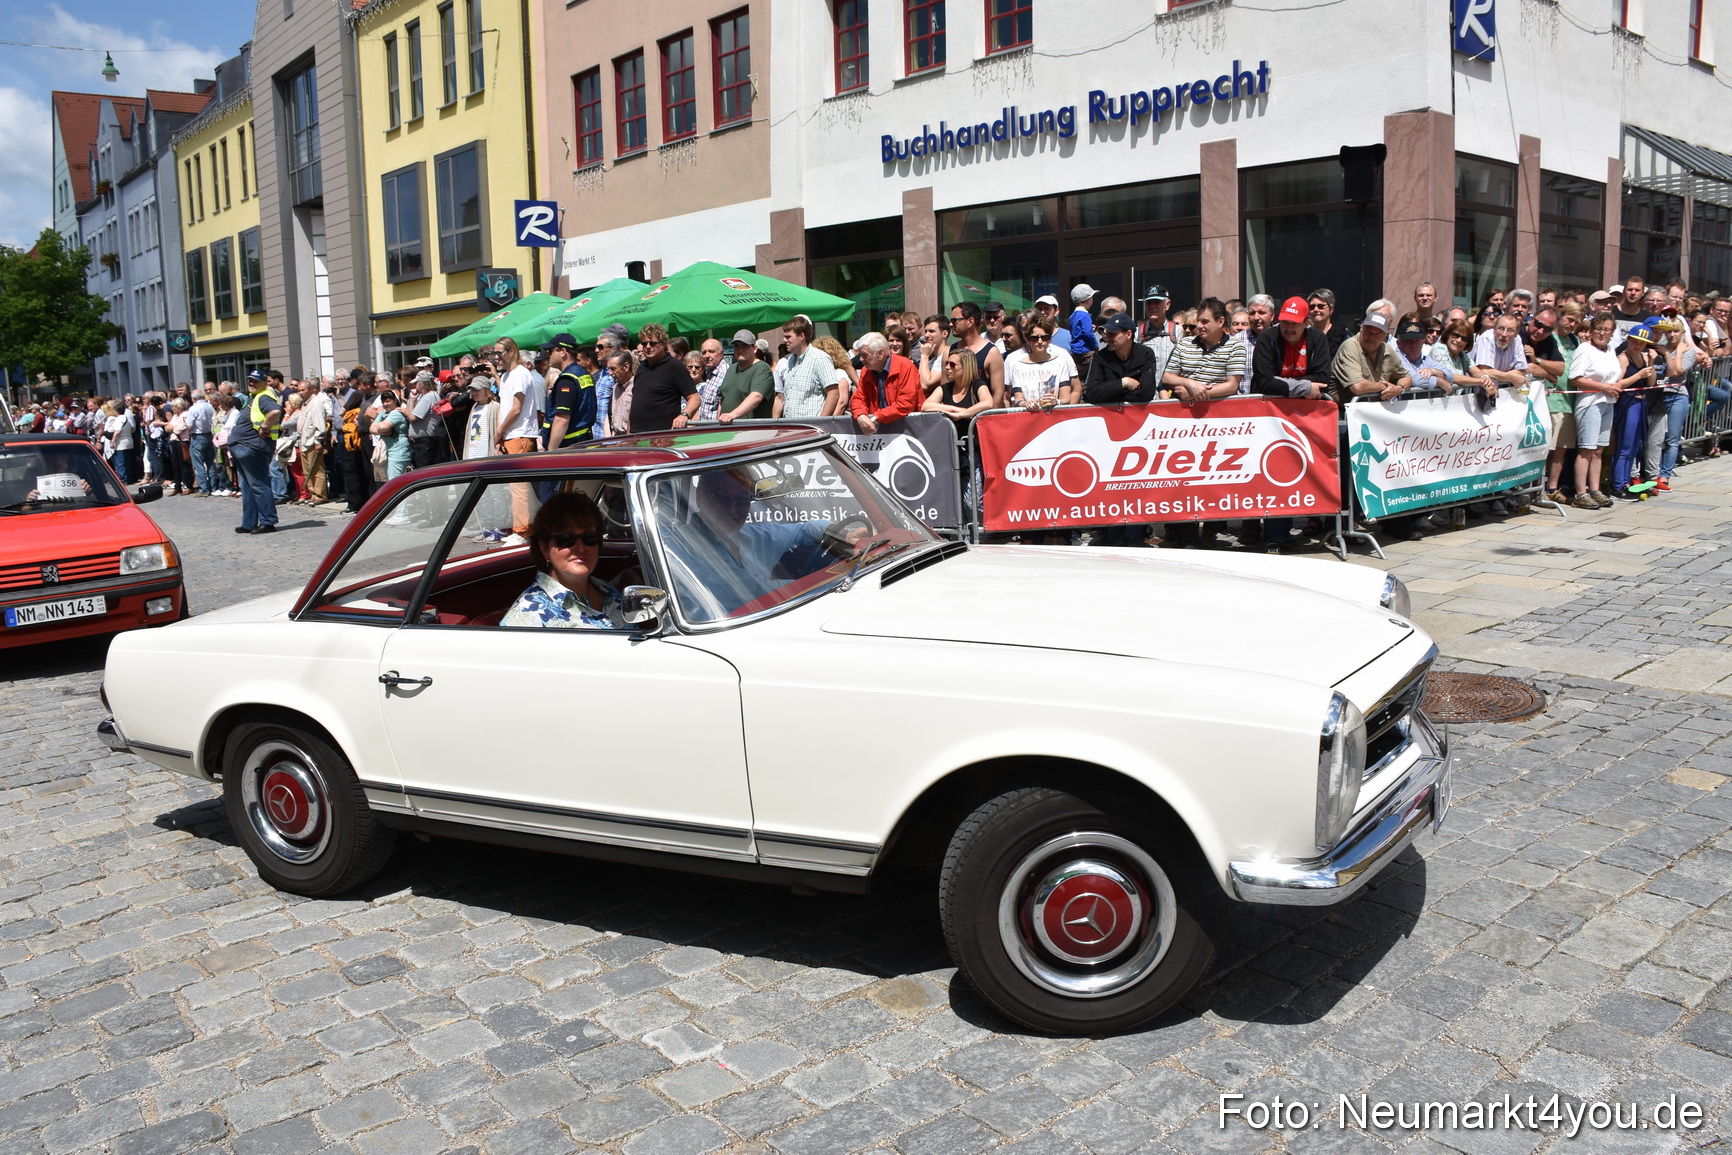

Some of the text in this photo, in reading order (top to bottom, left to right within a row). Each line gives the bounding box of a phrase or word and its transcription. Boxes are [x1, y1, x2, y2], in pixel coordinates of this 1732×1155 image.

[881, 60, 1271, 163] Buchhandlung Rupprecht
[563, 255, 596, 269] Unterer Markt 15
[494, 280, 508, 298] G2
[1144, 421, 1256, 441] Autoklassik
[1410, 431, 1448, 452] UNS
[1110, 441, 1250, 478] Dietz
[1452, 443, 1512, 468] BESSER
[60, 479, 77, 488] 356
[1104, 480, 1182, 491] BREITENBRUNN
[1007, 490, 1316, 522] www.autoklassik-dietz.de
[1387, 492, 1428, 506] Service-Line:
[16, 607, 36, 623] NM
[45, 603, 65, 619] NN
[67, 599, 94, 616] 143
